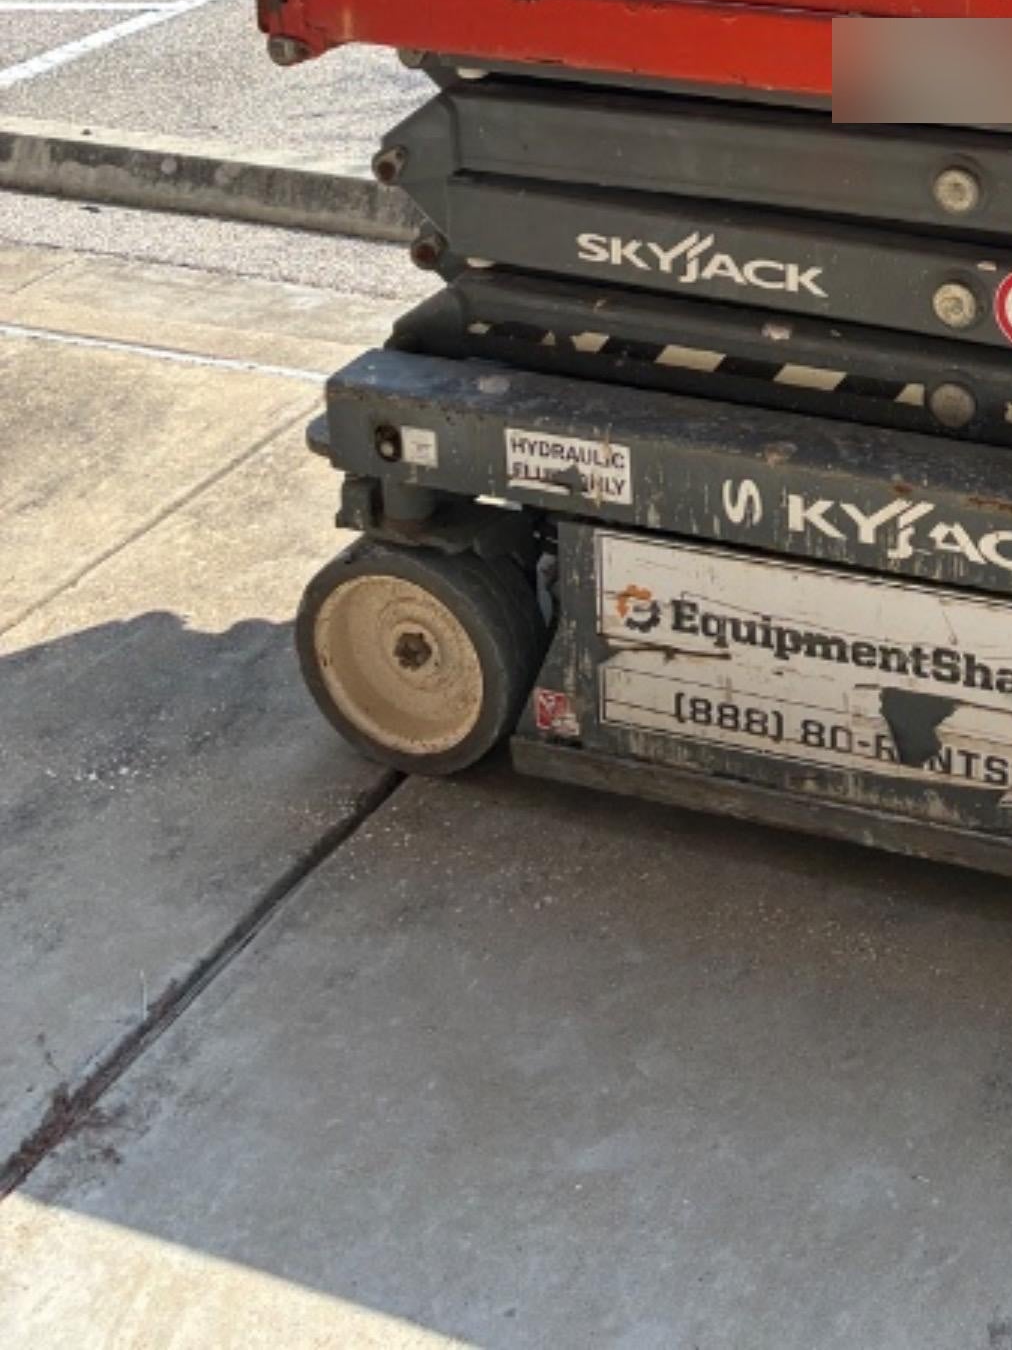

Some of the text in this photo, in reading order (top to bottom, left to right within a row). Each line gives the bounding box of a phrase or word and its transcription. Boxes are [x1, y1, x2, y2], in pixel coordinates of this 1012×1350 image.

[576, 231, 829, 298] SKYJACK
[674, 692, 1010, 788] (888) 80-RNTS
